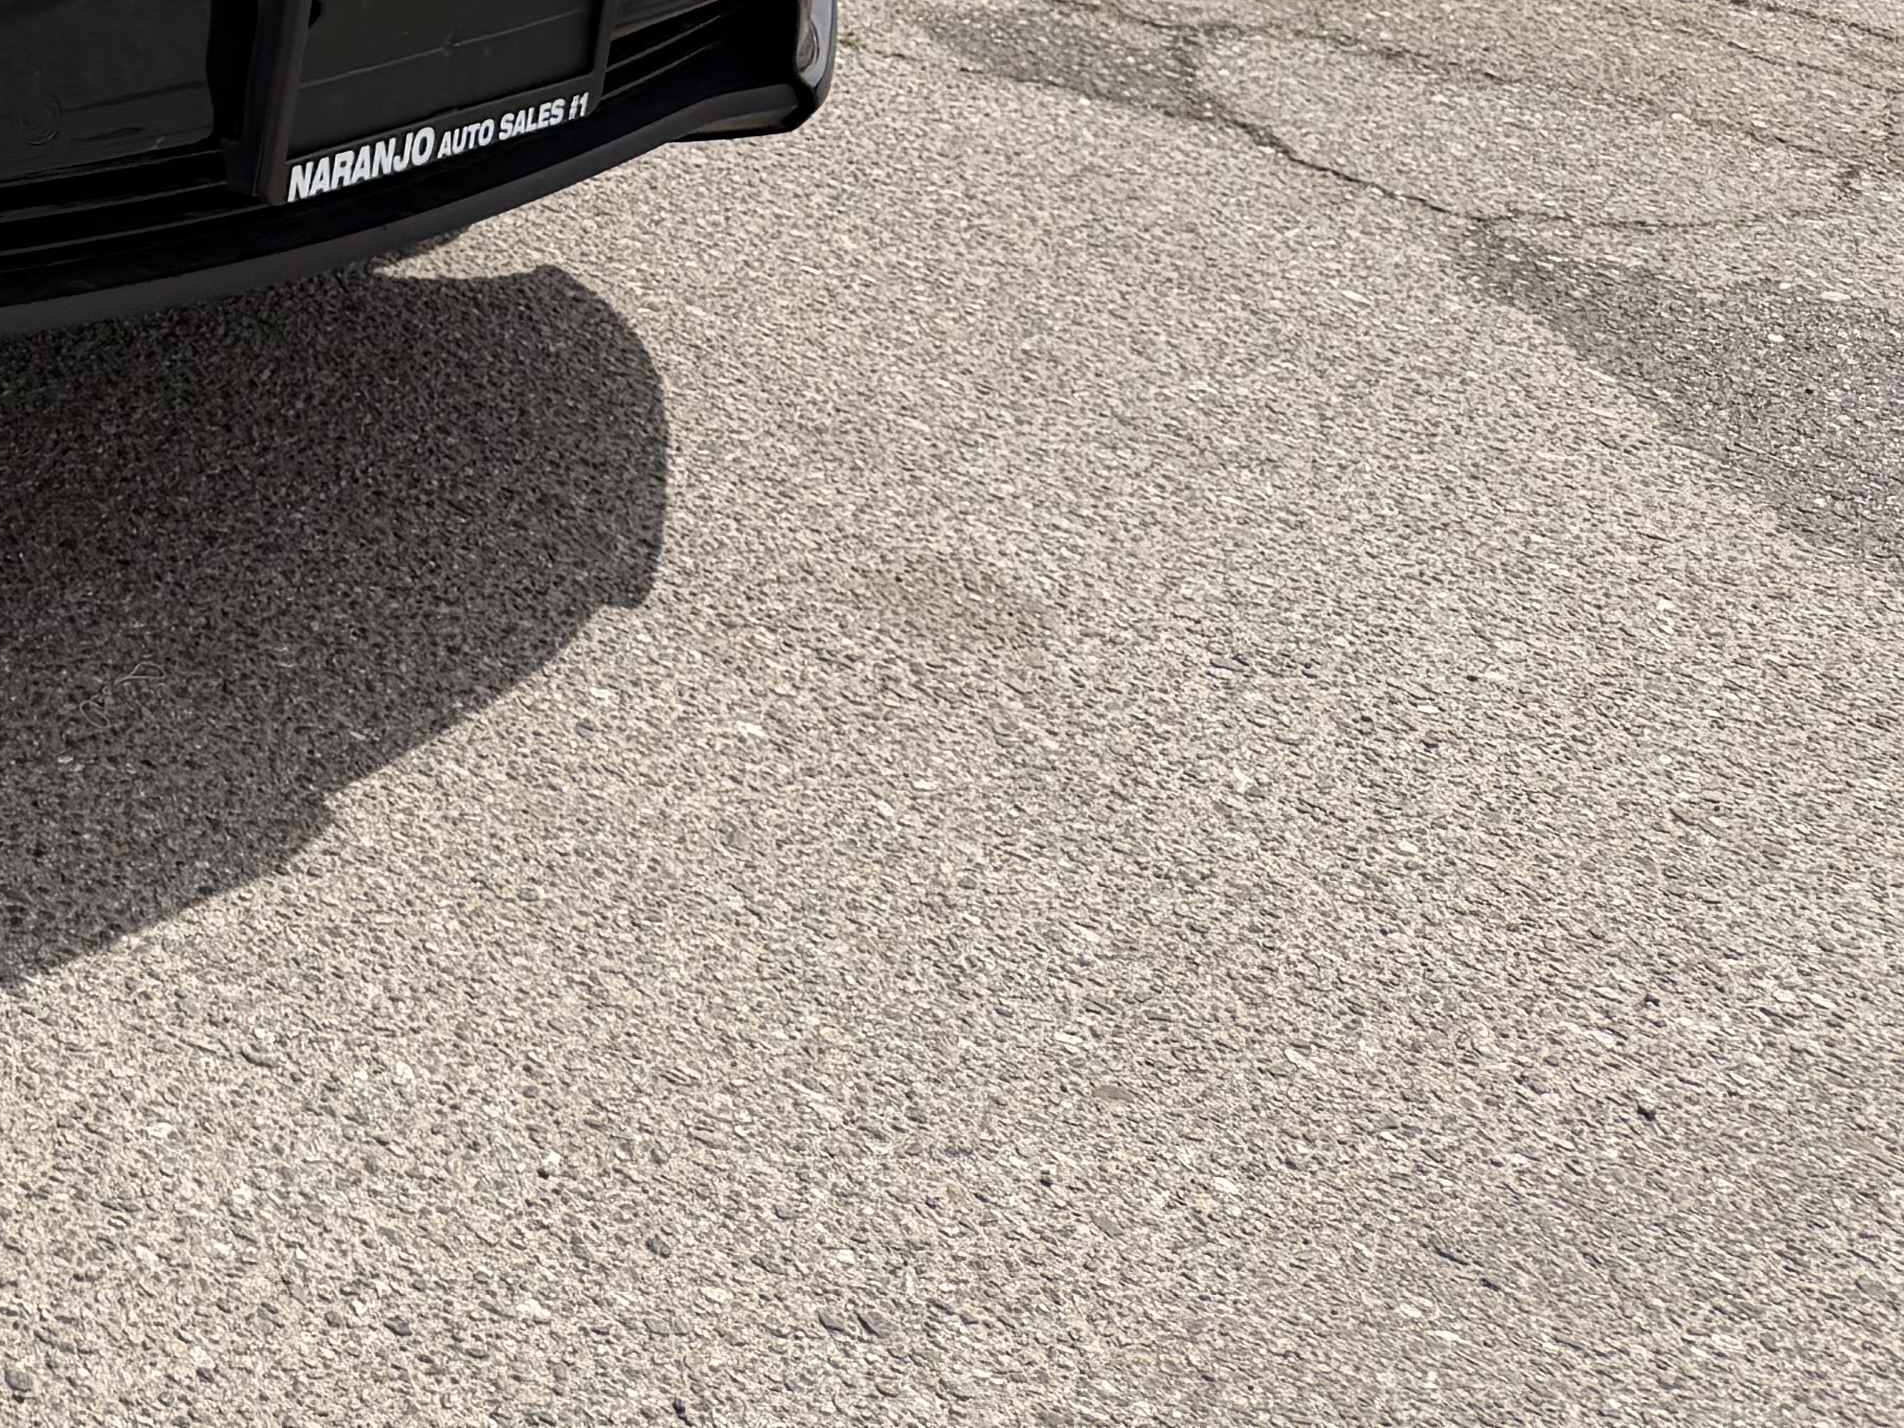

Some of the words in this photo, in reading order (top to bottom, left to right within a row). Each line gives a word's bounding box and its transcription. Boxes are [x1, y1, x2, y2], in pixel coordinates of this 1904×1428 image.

[287, 127, 435, 202] NARANJO
[437, 118, 495, 159] AUTO
[498, 98, 565, 140] SALES
[569, 91, 589, 121] #1
